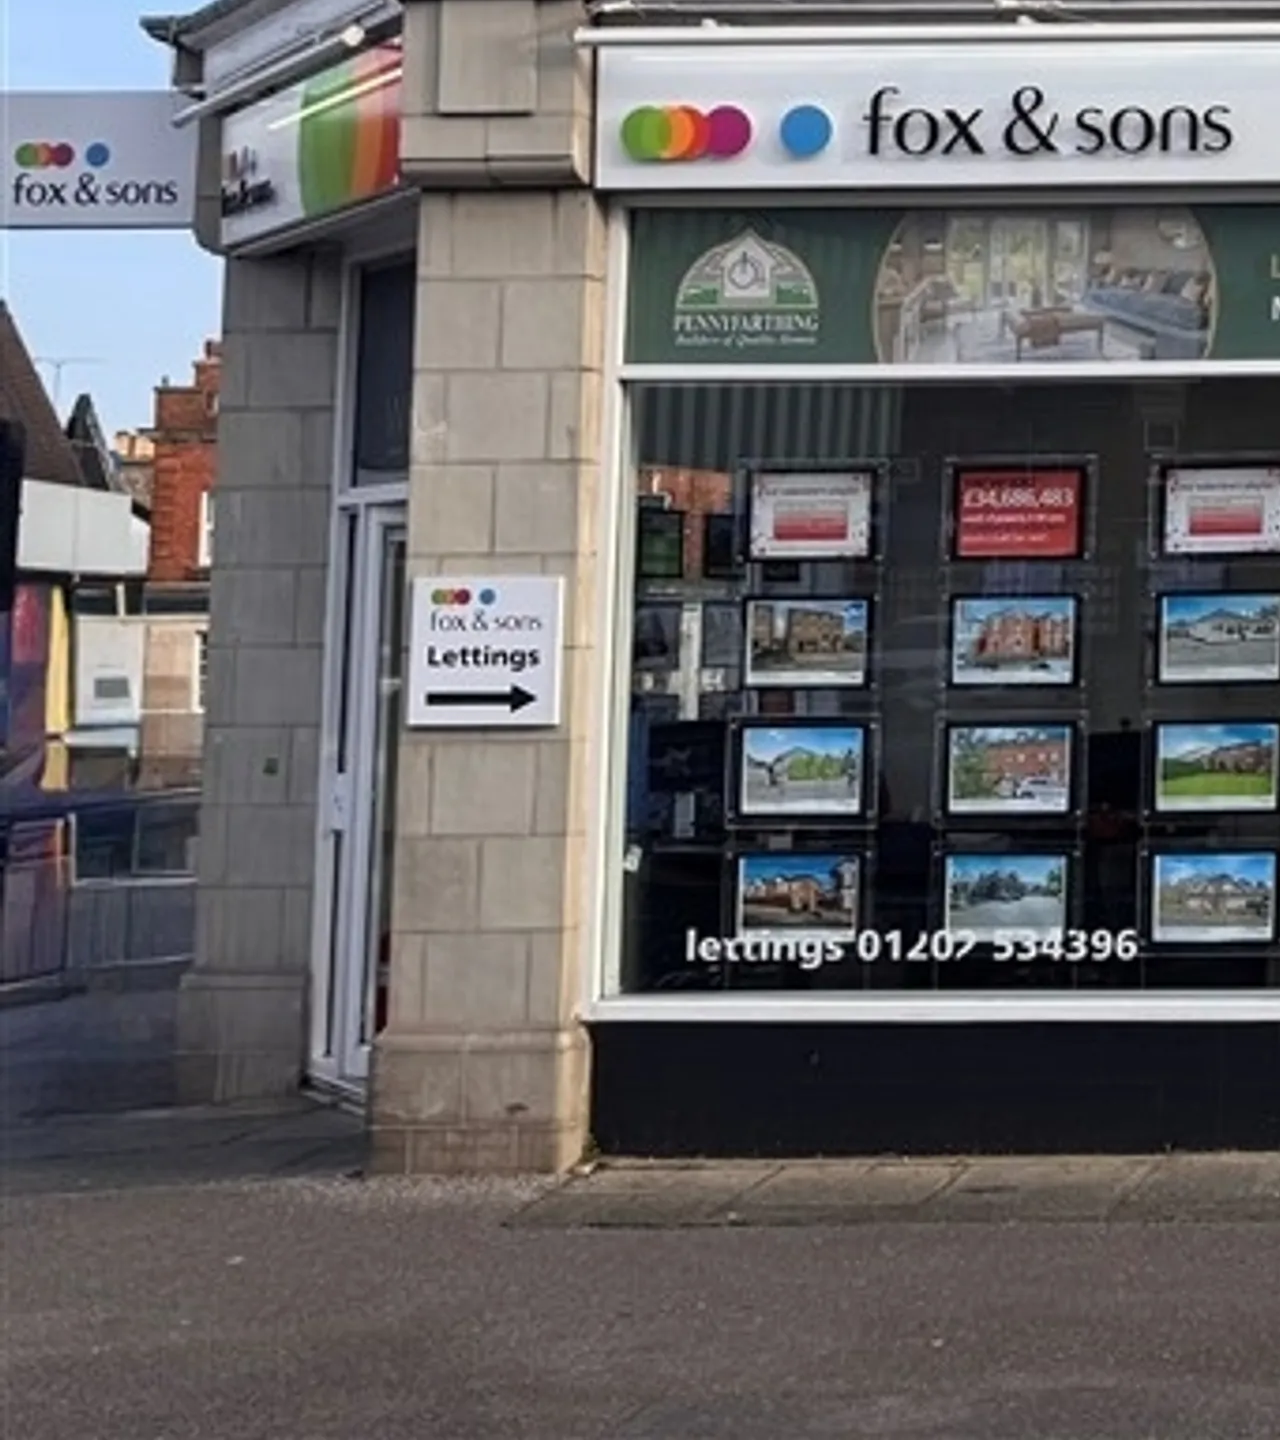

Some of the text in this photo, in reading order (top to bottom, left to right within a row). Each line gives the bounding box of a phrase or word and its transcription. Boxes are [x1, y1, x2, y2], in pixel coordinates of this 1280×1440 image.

[862, 85, 1233, 156] fox & sons
[13, 172, 179, 206] fox & sons
[430, 610, 542, 632] fox & sons
[427, 645, 541, 671] Lettings
[686, 929, 844, 969] lettings
[992, 928, 1138, 961] 534396
